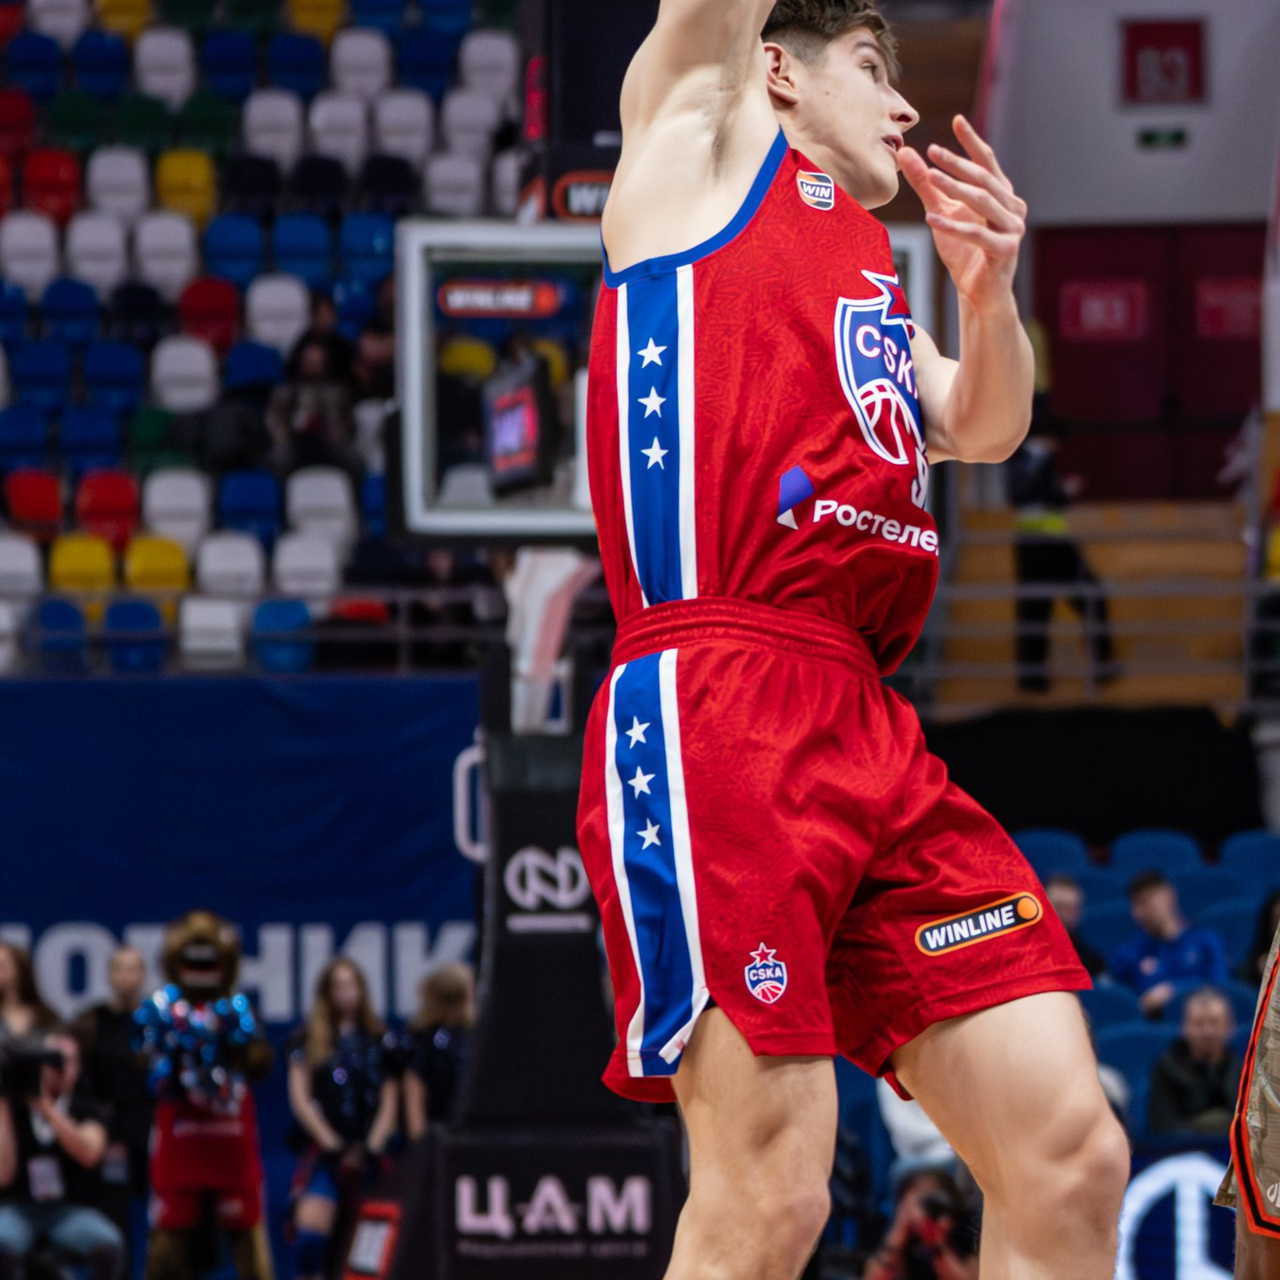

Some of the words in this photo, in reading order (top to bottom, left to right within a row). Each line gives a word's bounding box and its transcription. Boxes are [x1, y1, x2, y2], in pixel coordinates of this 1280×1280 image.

[803, 183, 831, 198] WIN
[855, 324, 918, 401] CSK
[813, 499, 939, 557] Ростеле
[925, 905, 1015, 950] WINLINE
[749, 966, 783, 981] CSKA
